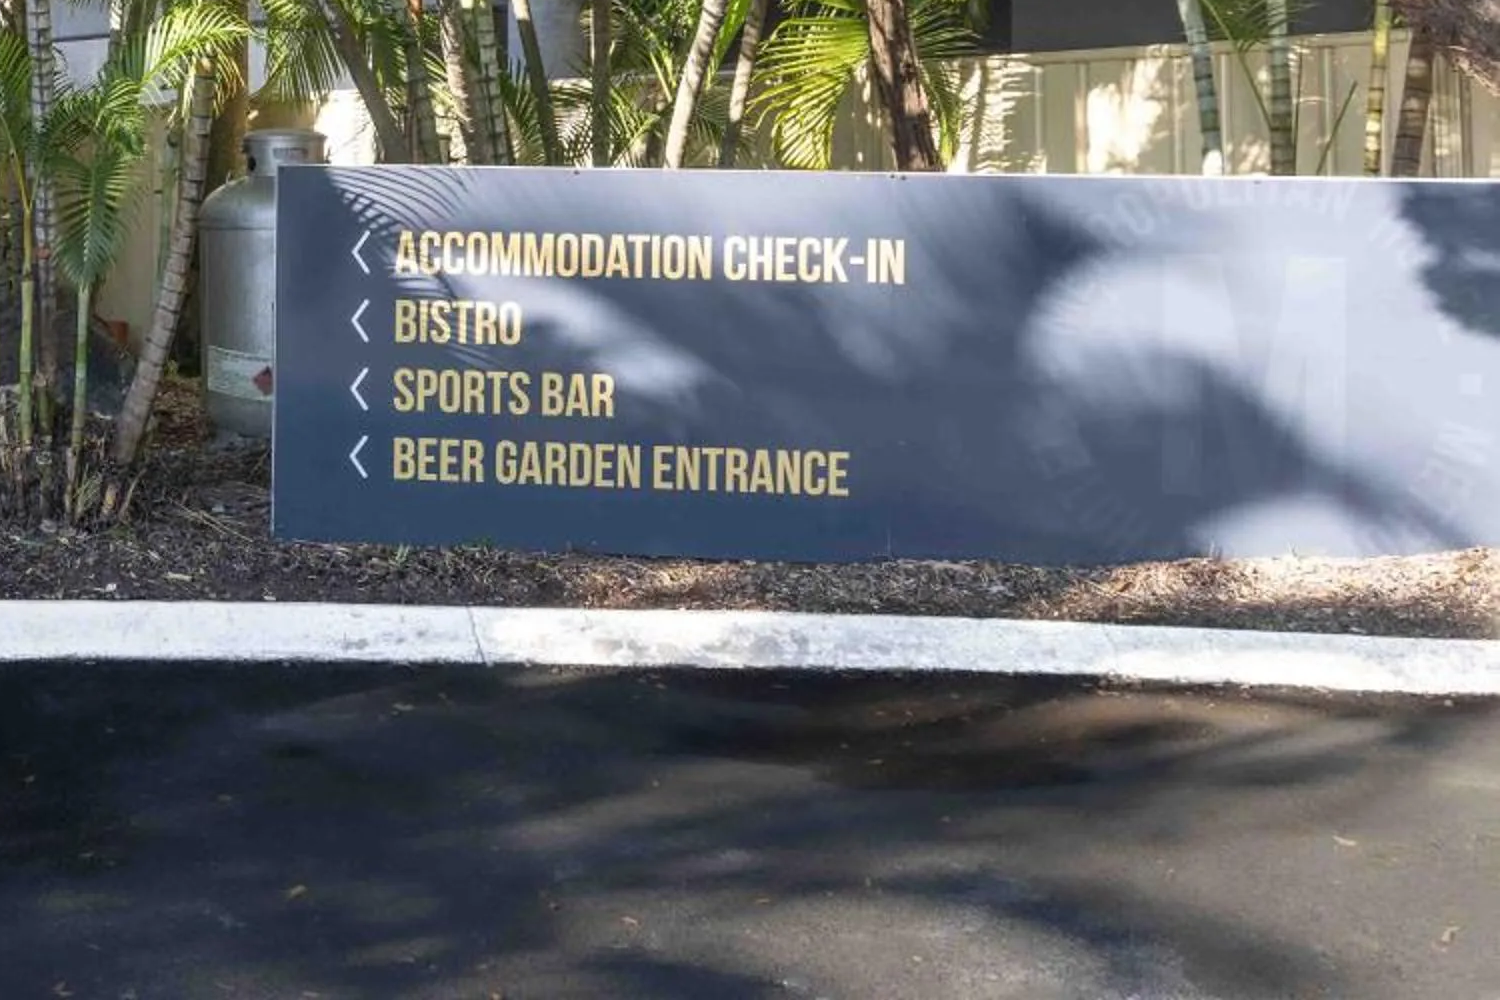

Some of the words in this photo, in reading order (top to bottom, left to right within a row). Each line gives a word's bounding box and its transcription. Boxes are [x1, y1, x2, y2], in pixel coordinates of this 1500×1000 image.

[395, 230, 712, 280] ACCOMMODATION
[723, 235, 905, 284] CHECK-IN
[395, 299, 522, 345] BISTRO
[393, 367, 531, 415] SPORTS
[541, 372, 615, 418] BAR
[393, 437, 485, 483] BEER
[495, 440, 641, 489] GARDEN
[653, 445, 850, 497] ENTRANCE
